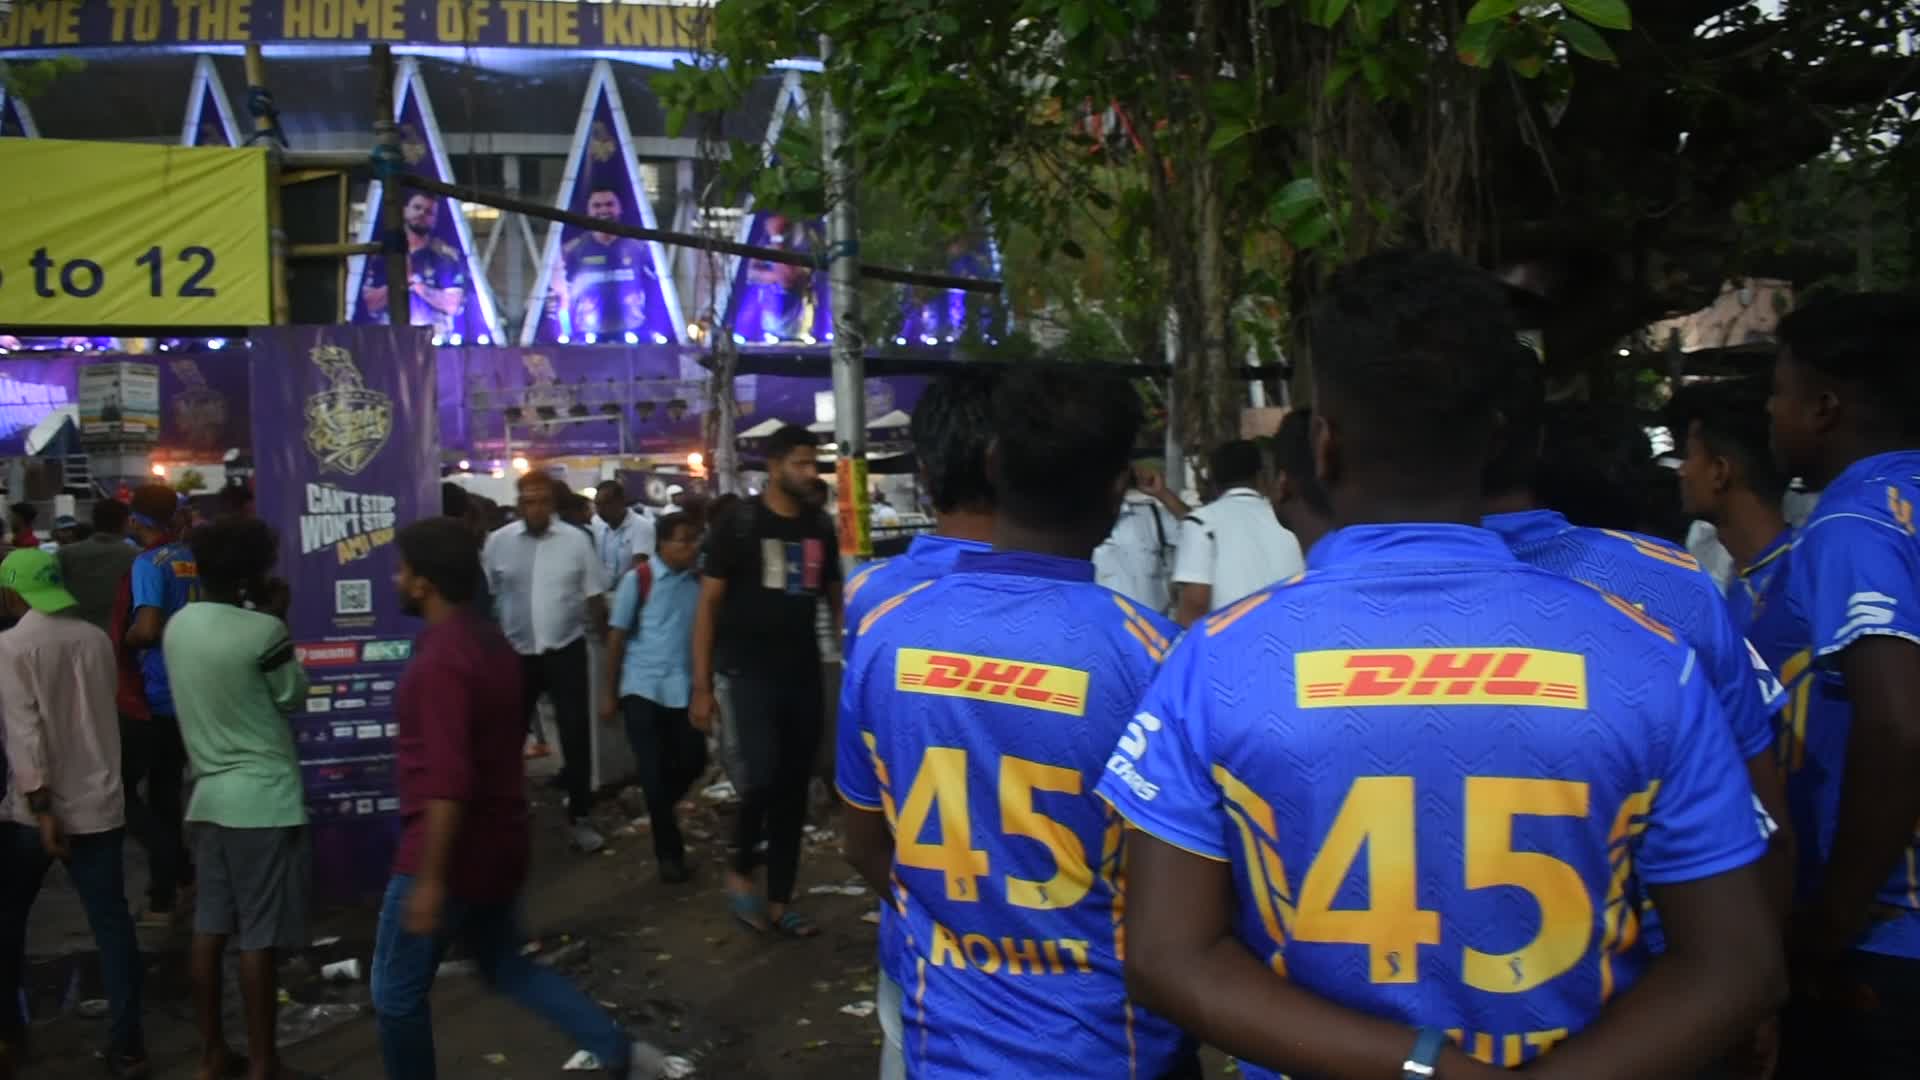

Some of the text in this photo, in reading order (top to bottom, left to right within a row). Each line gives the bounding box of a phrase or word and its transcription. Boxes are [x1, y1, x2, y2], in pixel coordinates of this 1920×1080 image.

[110, 0, 161, 42] TO
[174, 0, 250, 42] THE
[282, 0, 406, 40] HOME
[437, 0, 490, 43] OF
[502, 2, 580, 45] THE
[28, 246, 216, 299] to 12
[923, 654, 1054, 703] DHL
[1343, 652, 1543, 698] DHL
[894, 746, 1094, 910] 45
[1291, 775, 1594, 994] 45
[929, 921, 1094, 976] ROHIT
